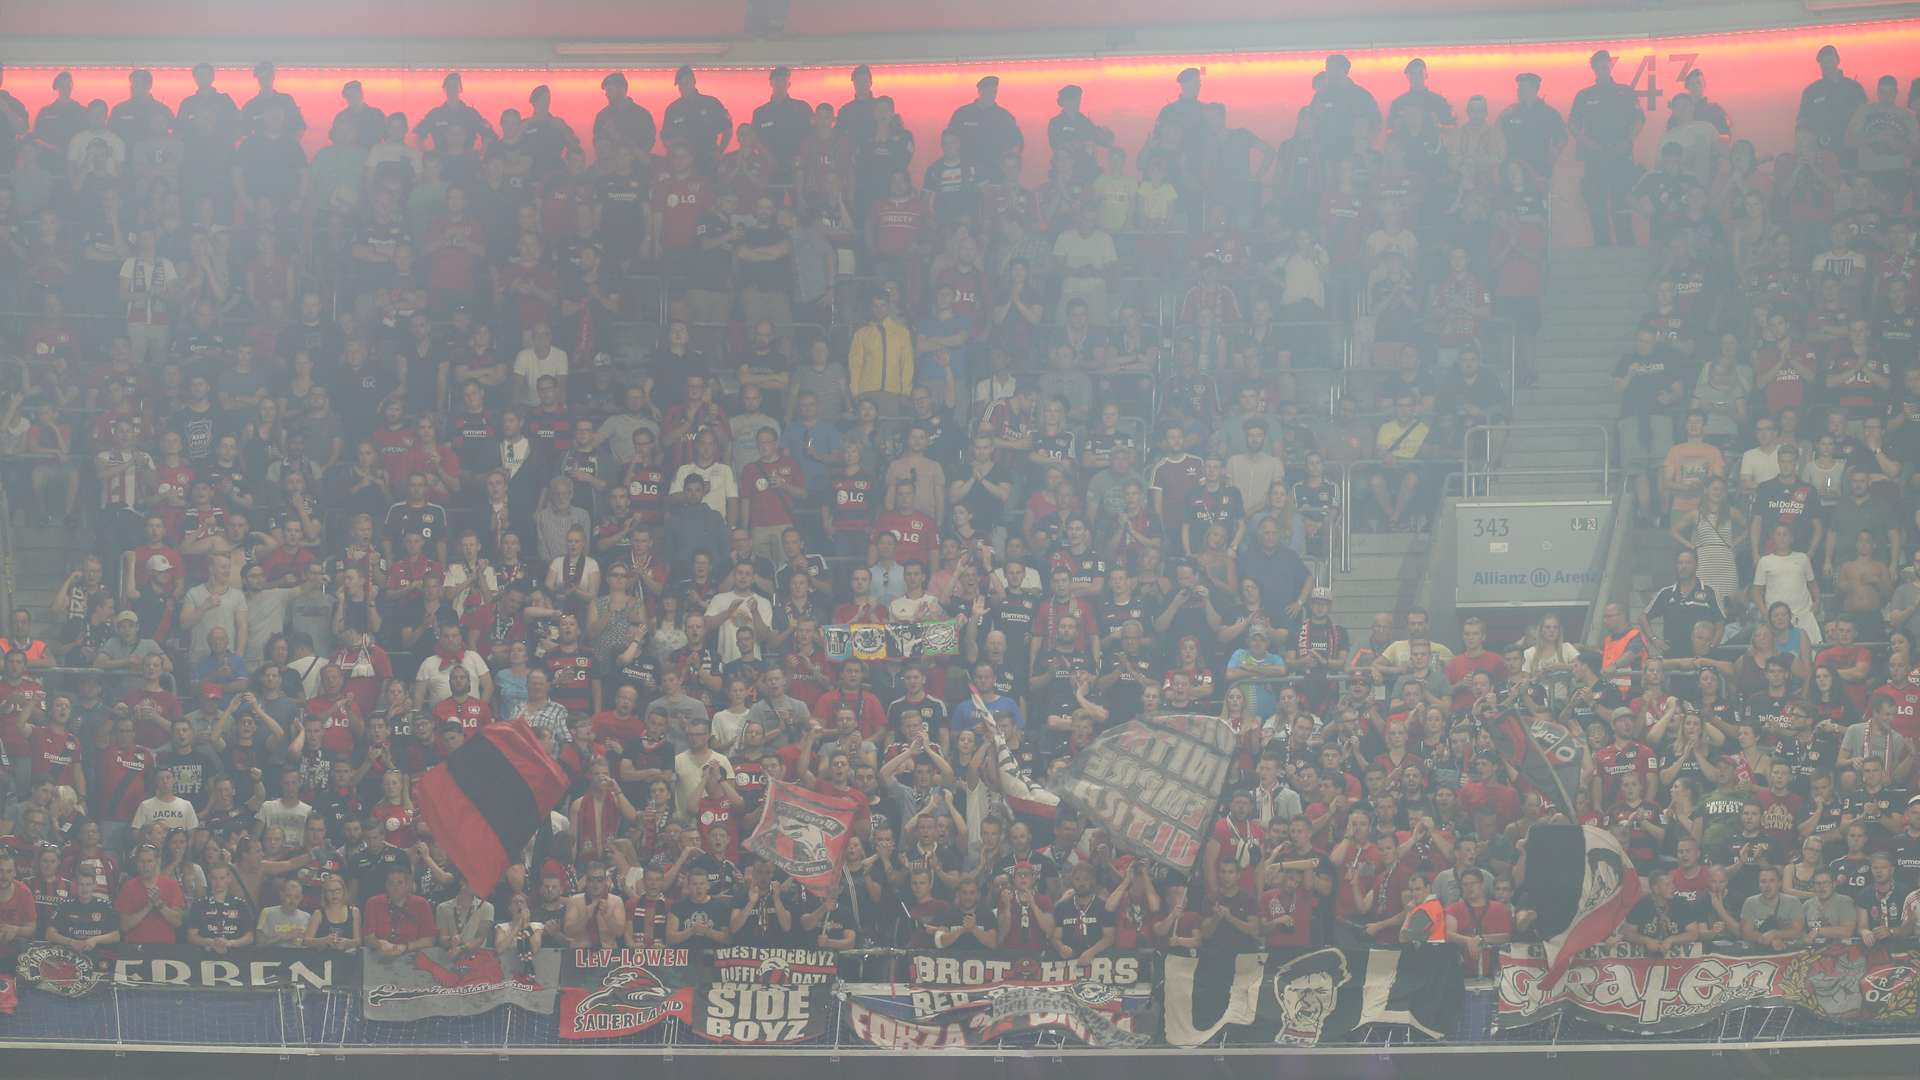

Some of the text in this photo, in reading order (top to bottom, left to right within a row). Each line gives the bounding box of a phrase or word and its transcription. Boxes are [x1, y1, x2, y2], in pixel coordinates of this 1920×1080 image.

[643, 483, 658, 495] LG
[850, 491, 865, 503] LG
[1473, 518, 1509, 538] 343
[903, 533, 919, 543] LG
[1473, 571, 1527, 585] Allianz
[1897, 705, 1914, 716] LG
[462, 717, 478, 729] LG
[1848, 875, 1865, 887] LG
[707, 985, 811, 1021] SIDE
[573, 999, 684, 1033] SAUERLAND
[706, 1016, 809, 1042] BOYZ
